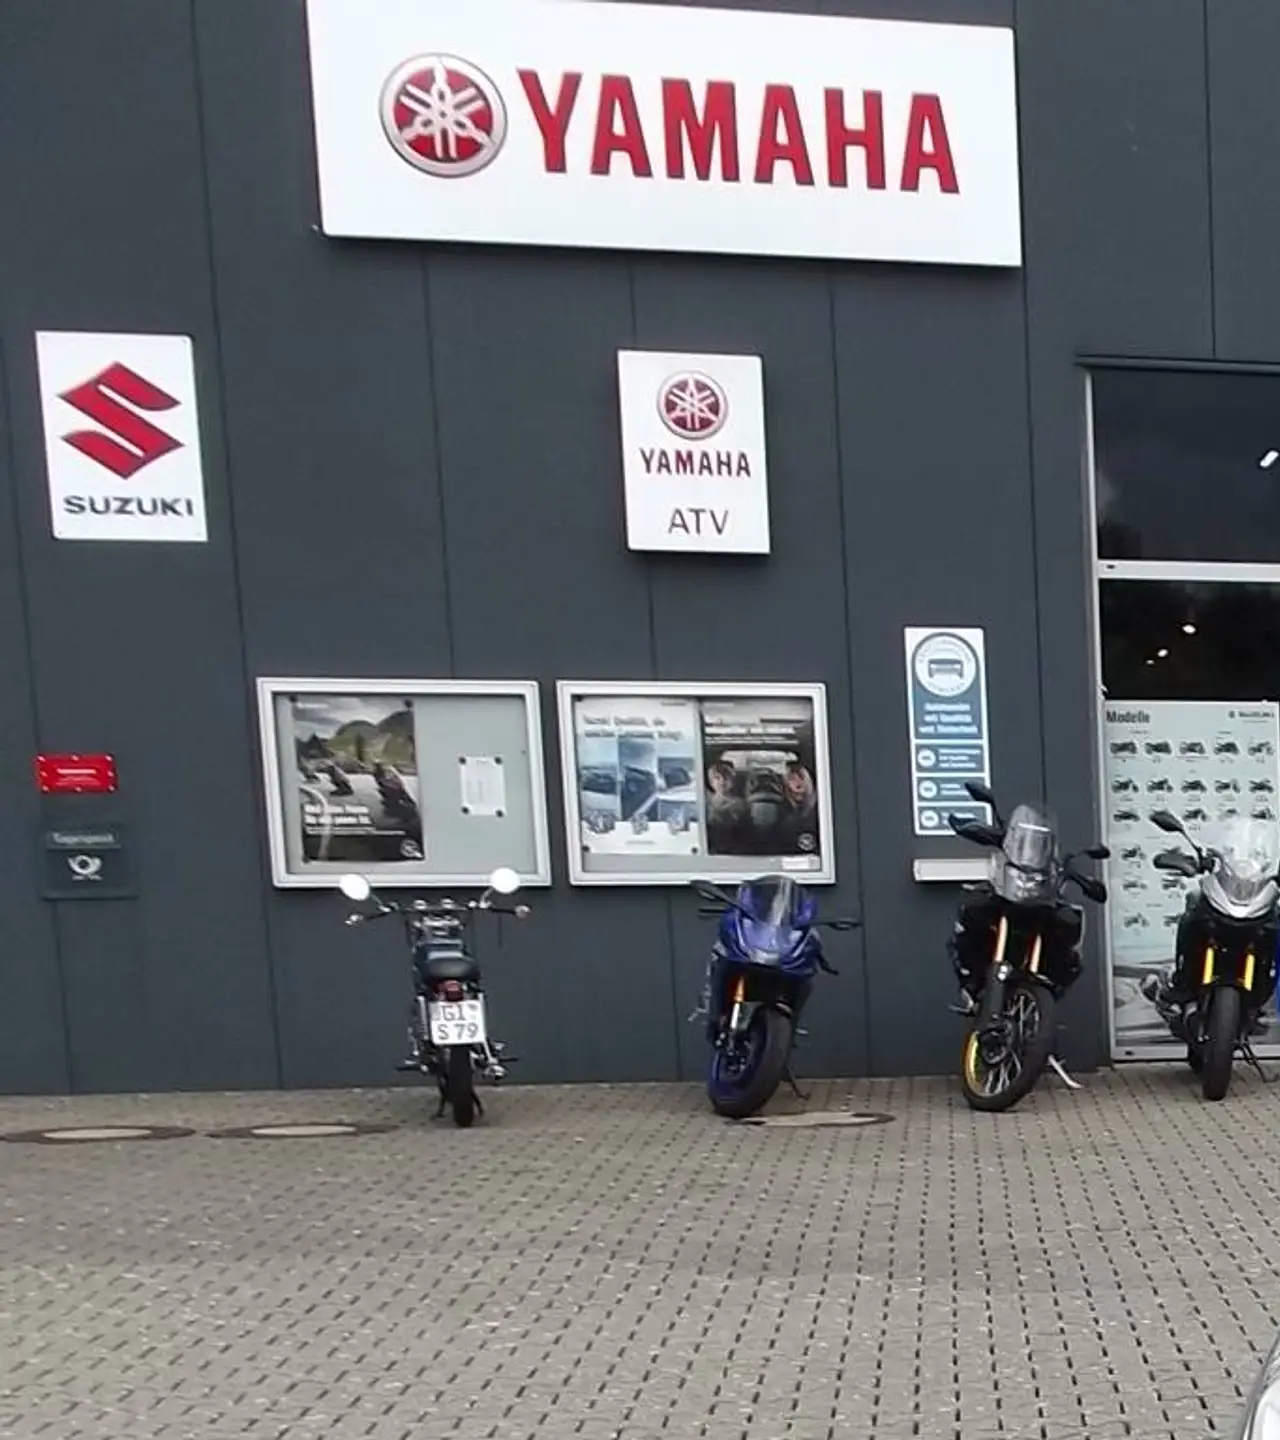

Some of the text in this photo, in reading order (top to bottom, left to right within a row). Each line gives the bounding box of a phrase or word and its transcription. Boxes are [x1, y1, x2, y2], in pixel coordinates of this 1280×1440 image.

[516, 68, 960, 195] YAMAHA
[639, 447, 752, 478] YAMAHA
[62, 495, 195, 517] SUZUKI
[668, 507, 729, 536] ATV
[1106, 711, 1150, 724] Modelle
[437, 1022, 479, 1040] S 79
